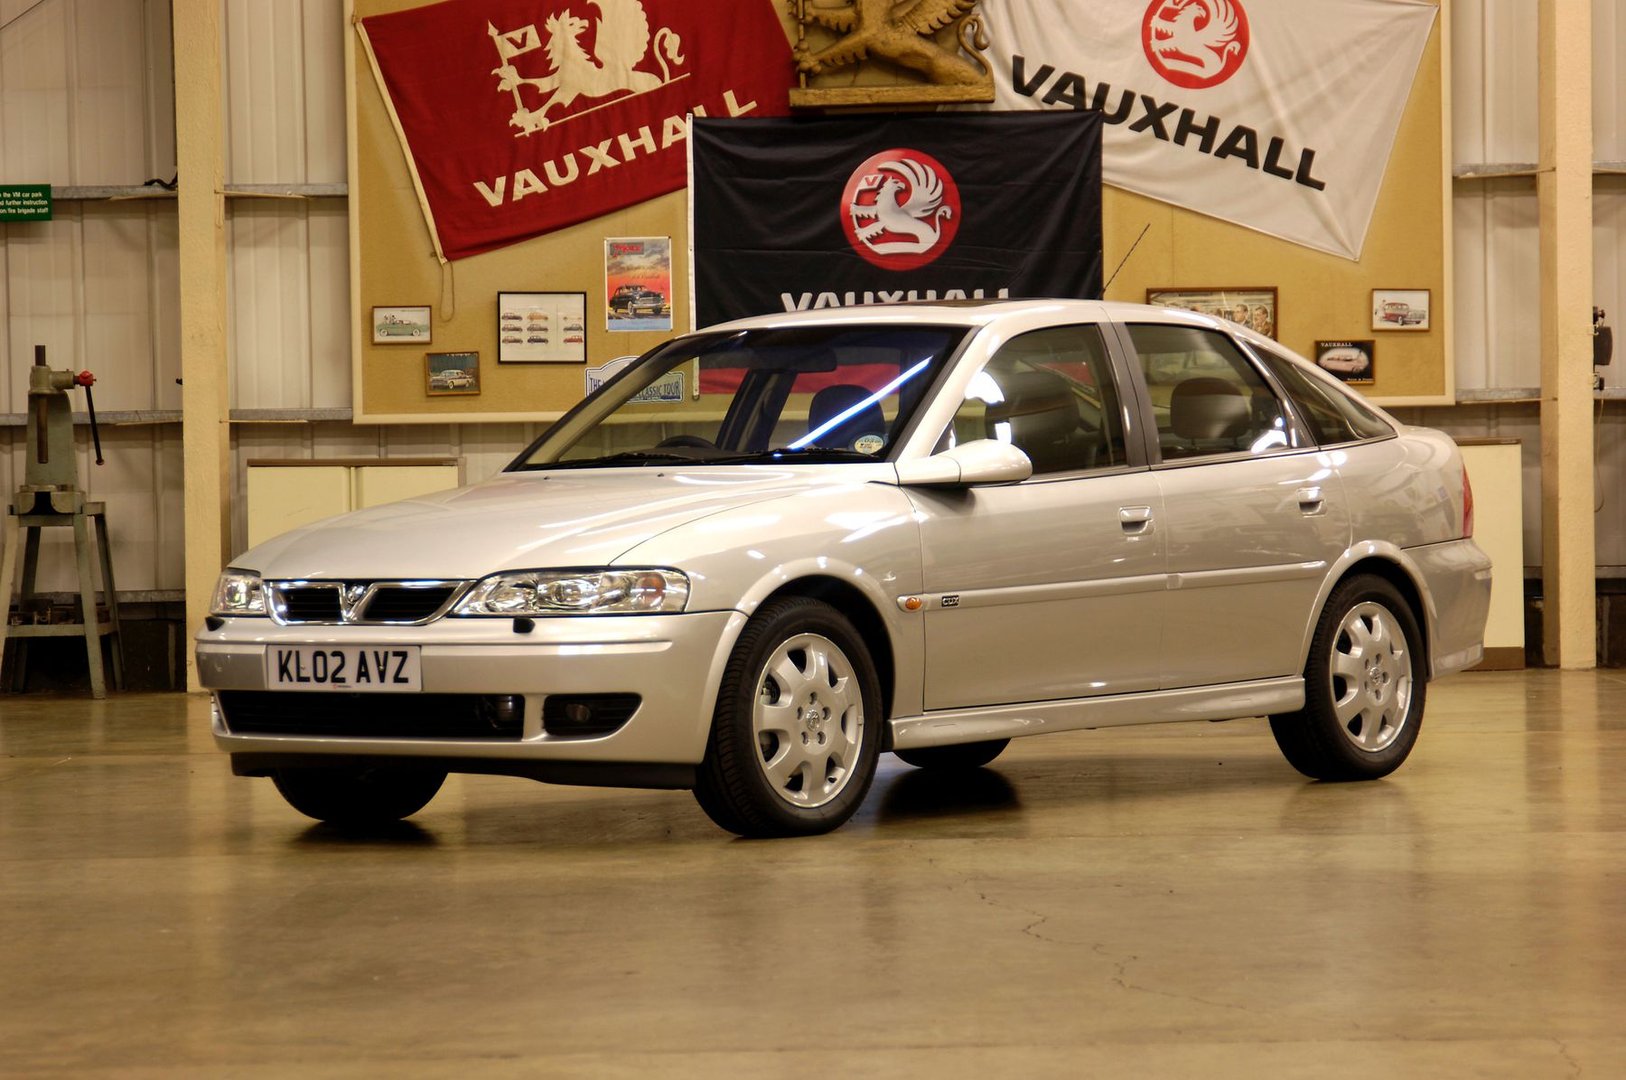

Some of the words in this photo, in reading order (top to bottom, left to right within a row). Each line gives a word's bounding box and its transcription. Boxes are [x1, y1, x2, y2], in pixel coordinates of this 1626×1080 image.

[1012, 54, 1326, 191] VAUXHALL
[278, 650, 346, 683] KL02
[356, 650, 409, 684] AVZ
